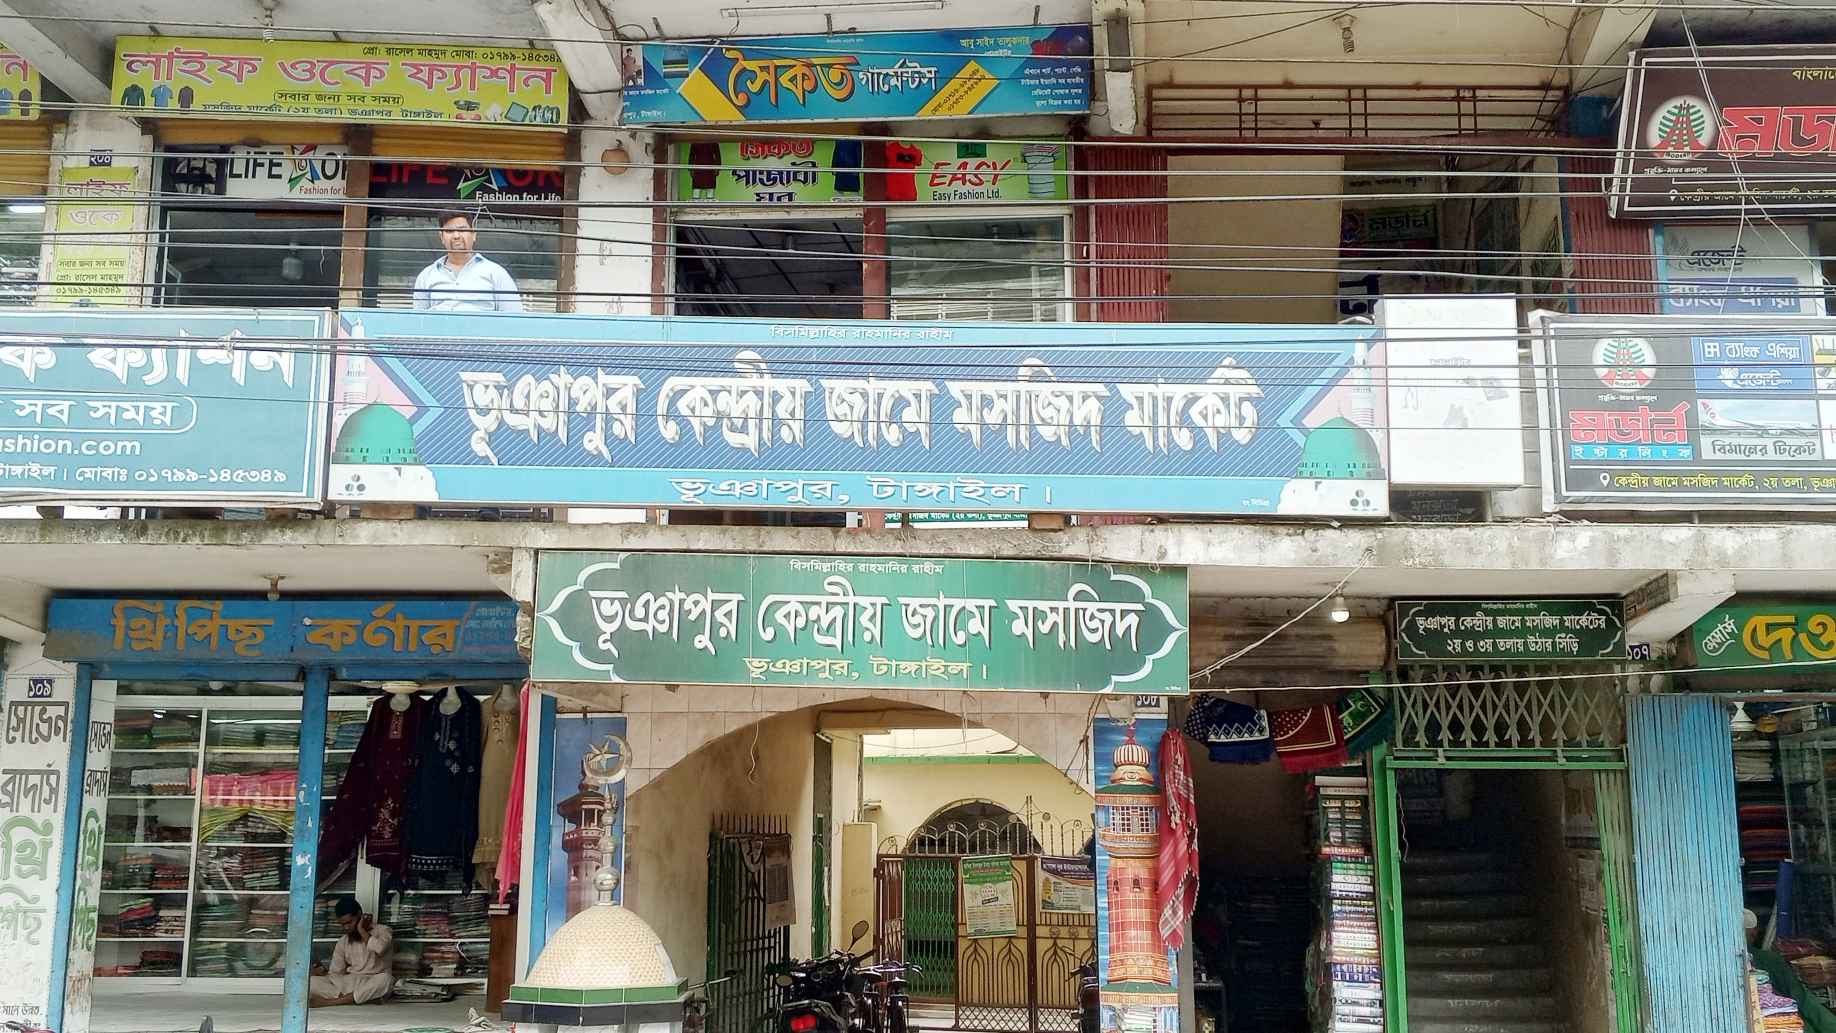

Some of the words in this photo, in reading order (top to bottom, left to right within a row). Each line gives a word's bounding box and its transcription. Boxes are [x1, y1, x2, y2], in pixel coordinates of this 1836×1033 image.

[120, 46, 263, 85] লাইফ
[277, 57, 390, 89] ওকে
[399, 60, 559, 97] ফ্যাশন
[723, 48, 858, 107] সৈকত
[277, 91, 310, 102] সবার
[346, 93, 366, 104] সব
[228, 150, 284, 180] LIFE
[928, 159, 1011, 188] EASY
[299, 185, 329, 196] Fashion
[330, 186, 342, 195] for
[475, 190, 520, 201] Fashion
[522, 191, 539, 201] for
[932, 190, 951, 202] Easy
[953, 189, 985, 201] Fashion
[986, 188, 1002, 200] Ltd.
[1724, 343, 1761, 358] ব্যাংক
[1765, 342, 1801, 360] এশিয়া
[11, 399, 77, 425] সব
[85, 399, 181, 427] সময়
[459, 365, 646, 465] ভূঞাপুর
[656, 350, 815, 458] কেন্দ্রীয়
[821, 373, 943, 452] জামে
[945, 357, 1109, 453] মসজিদ
[1118, 355, 1265, 455] মার্কেট
[1568, 401, 1691, 444] মডার্ন
[0, 432, 142, 456] shion.com
[1711, 439, 1769, 458] বিমানের
[1772, 439, 1816, 458] টিকেট
[134, 469, 287, 484] ০১৭৯৯-১৪৫৩৪৯
[866, 475, 1028, 504] টাঙ্গাইল
[1613, 472, 1649, 489] কেন্দ্রীয়
[1652, 474, 1678, 488] জামে
[1682, 473, 1718, 488] মসজিদ
[588, 584, 746, 658] ভূঞাপুর
[757, 575, 892, 653] কেন্দ্রীয়
[896, 590, 998, 650] জামে
[1004, 582, 1146, 652] মসজিদ
[1415, 614, 1456, 636] ভূঞাপুর
[1459, 610, 1493, 633] কেন্দ্রীয়
[1496, 614, 1522, 631] জামে
[1525, 611, 1561, 631] মসজিদ
[1563, 611, 1607, 632] মার্কেটের
[1446, 639, 1462, 654] ২য়
[1476, 638, 1494, 653] ৩য়
[1496, 638, 1524, 654] তলায়
[1527, 635, 1553, 654] উঠার
[743, 657, 860, 681] ভূঞাপুর,
[869, 655, 973, 681] টাঙ্গাইল
[29, 679, 52, 697] ১০৯
[6, 700, 70, 745] সেভেন
[88, 721, 113, 754] সেভেন
